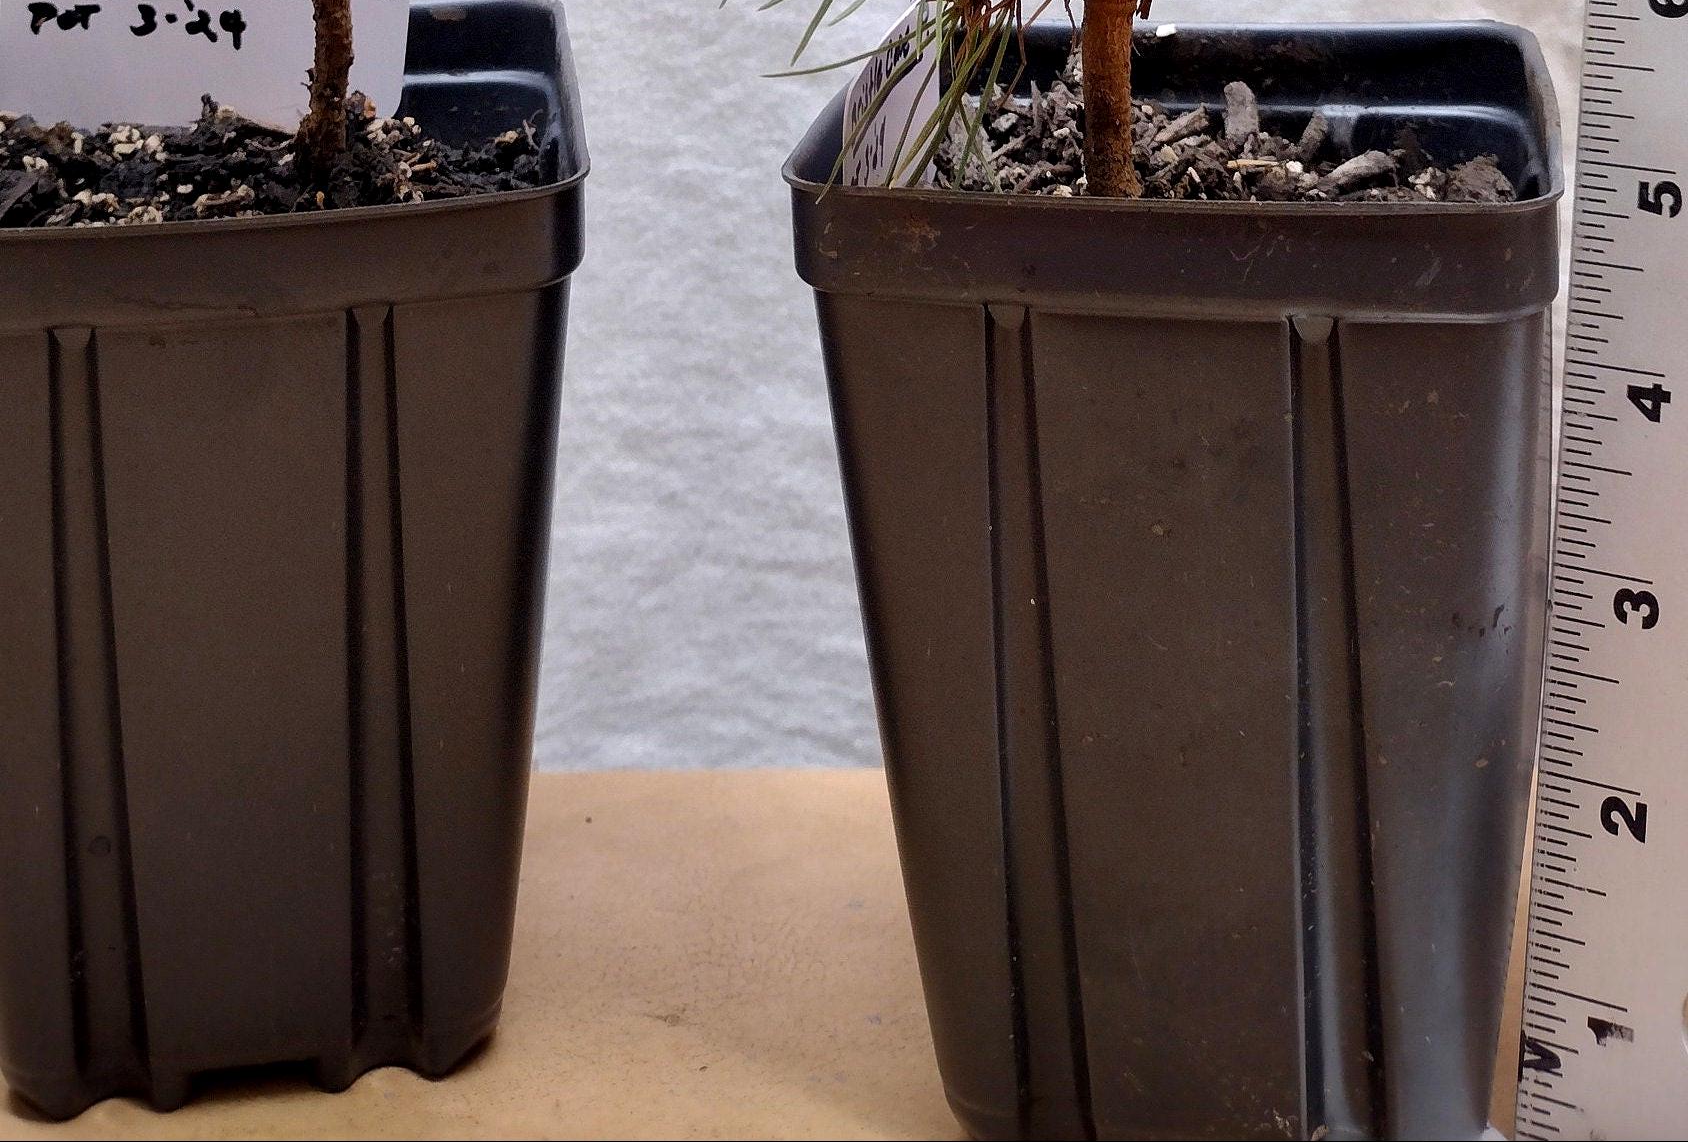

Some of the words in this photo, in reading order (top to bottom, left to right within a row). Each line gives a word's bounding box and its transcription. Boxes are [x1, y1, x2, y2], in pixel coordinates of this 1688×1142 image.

[1636, 180, 1683, 219] 5
[1625, 383, 1672, 424] 4
[1612, 587, 1660, 630] 3
[1600, 795, 1648, 844] 2
